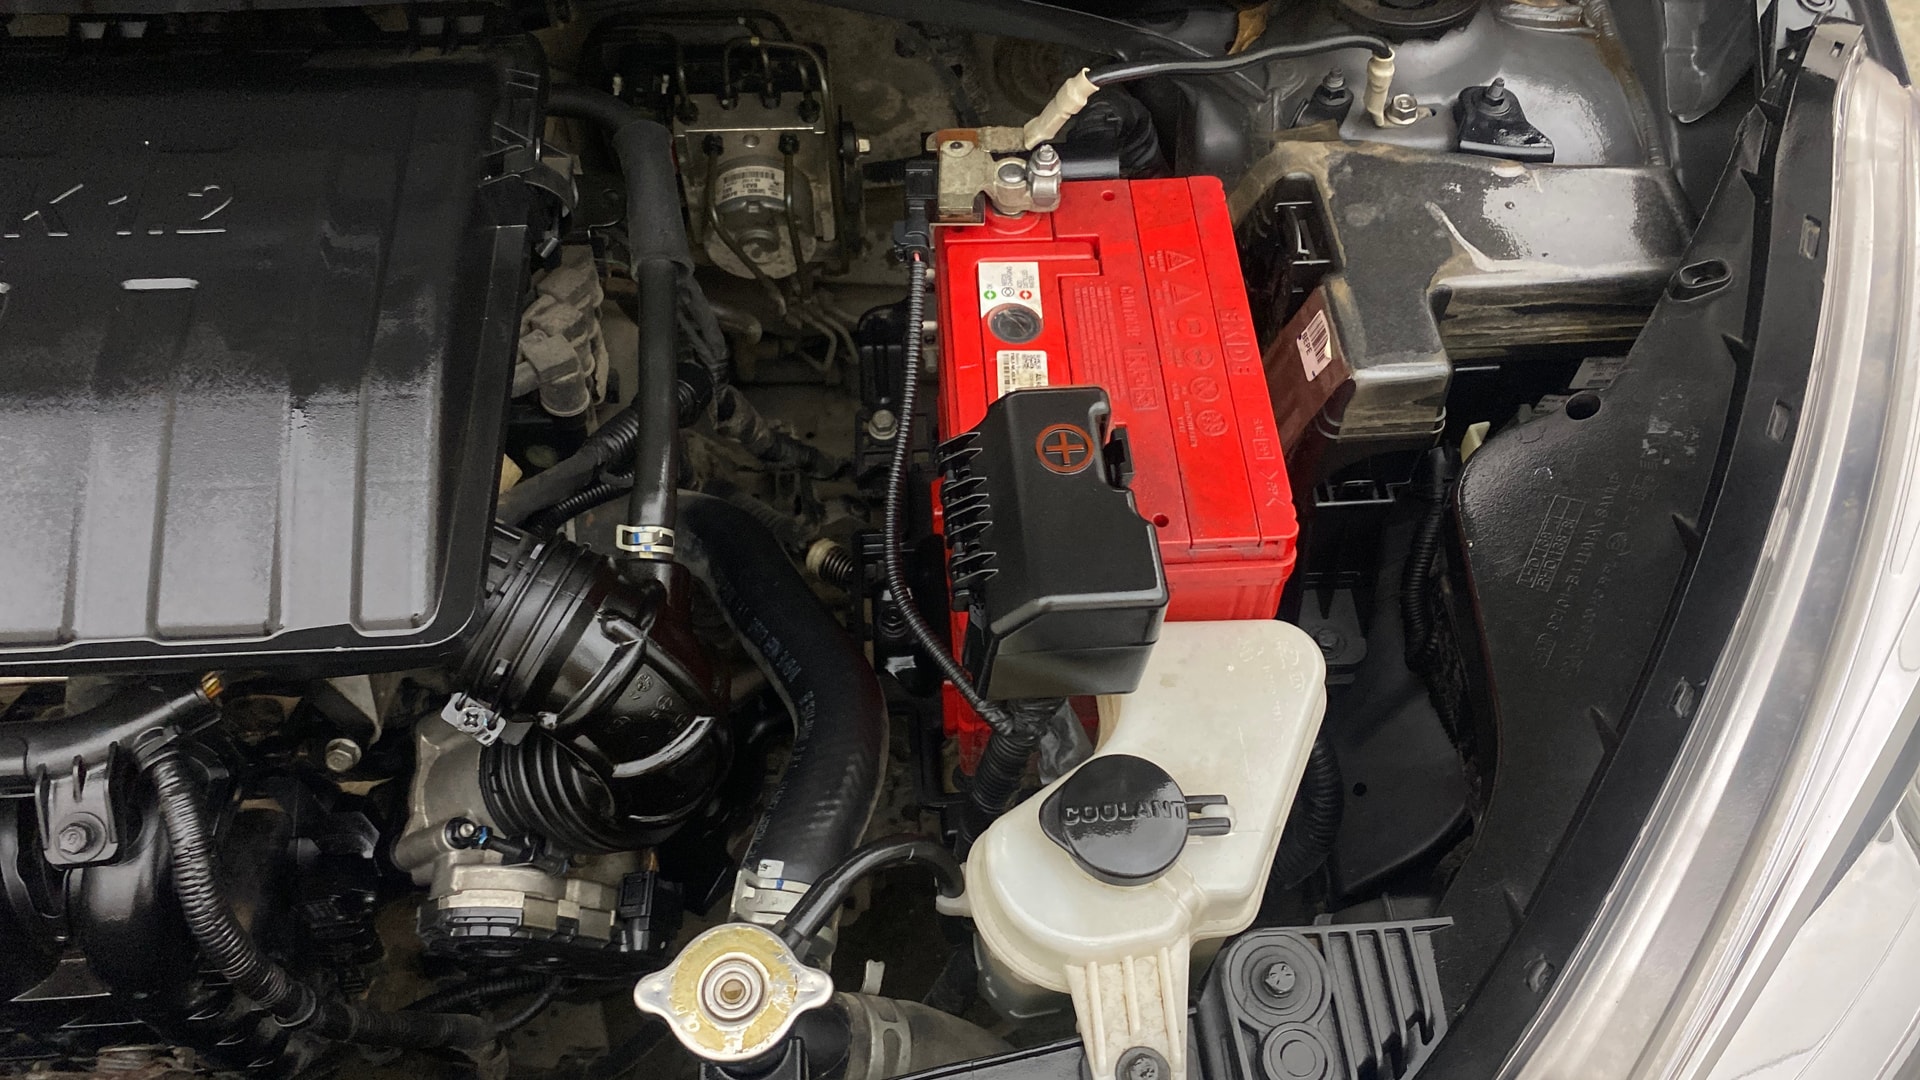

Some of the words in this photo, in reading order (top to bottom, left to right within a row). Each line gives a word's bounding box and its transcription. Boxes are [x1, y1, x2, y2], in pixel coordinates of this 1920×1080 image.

[1005, 265, 1013, 287] CHARGING
[1218, 307, 1257, 377] EXIDE
[1062, 799, 1188, 827] COOLANT
